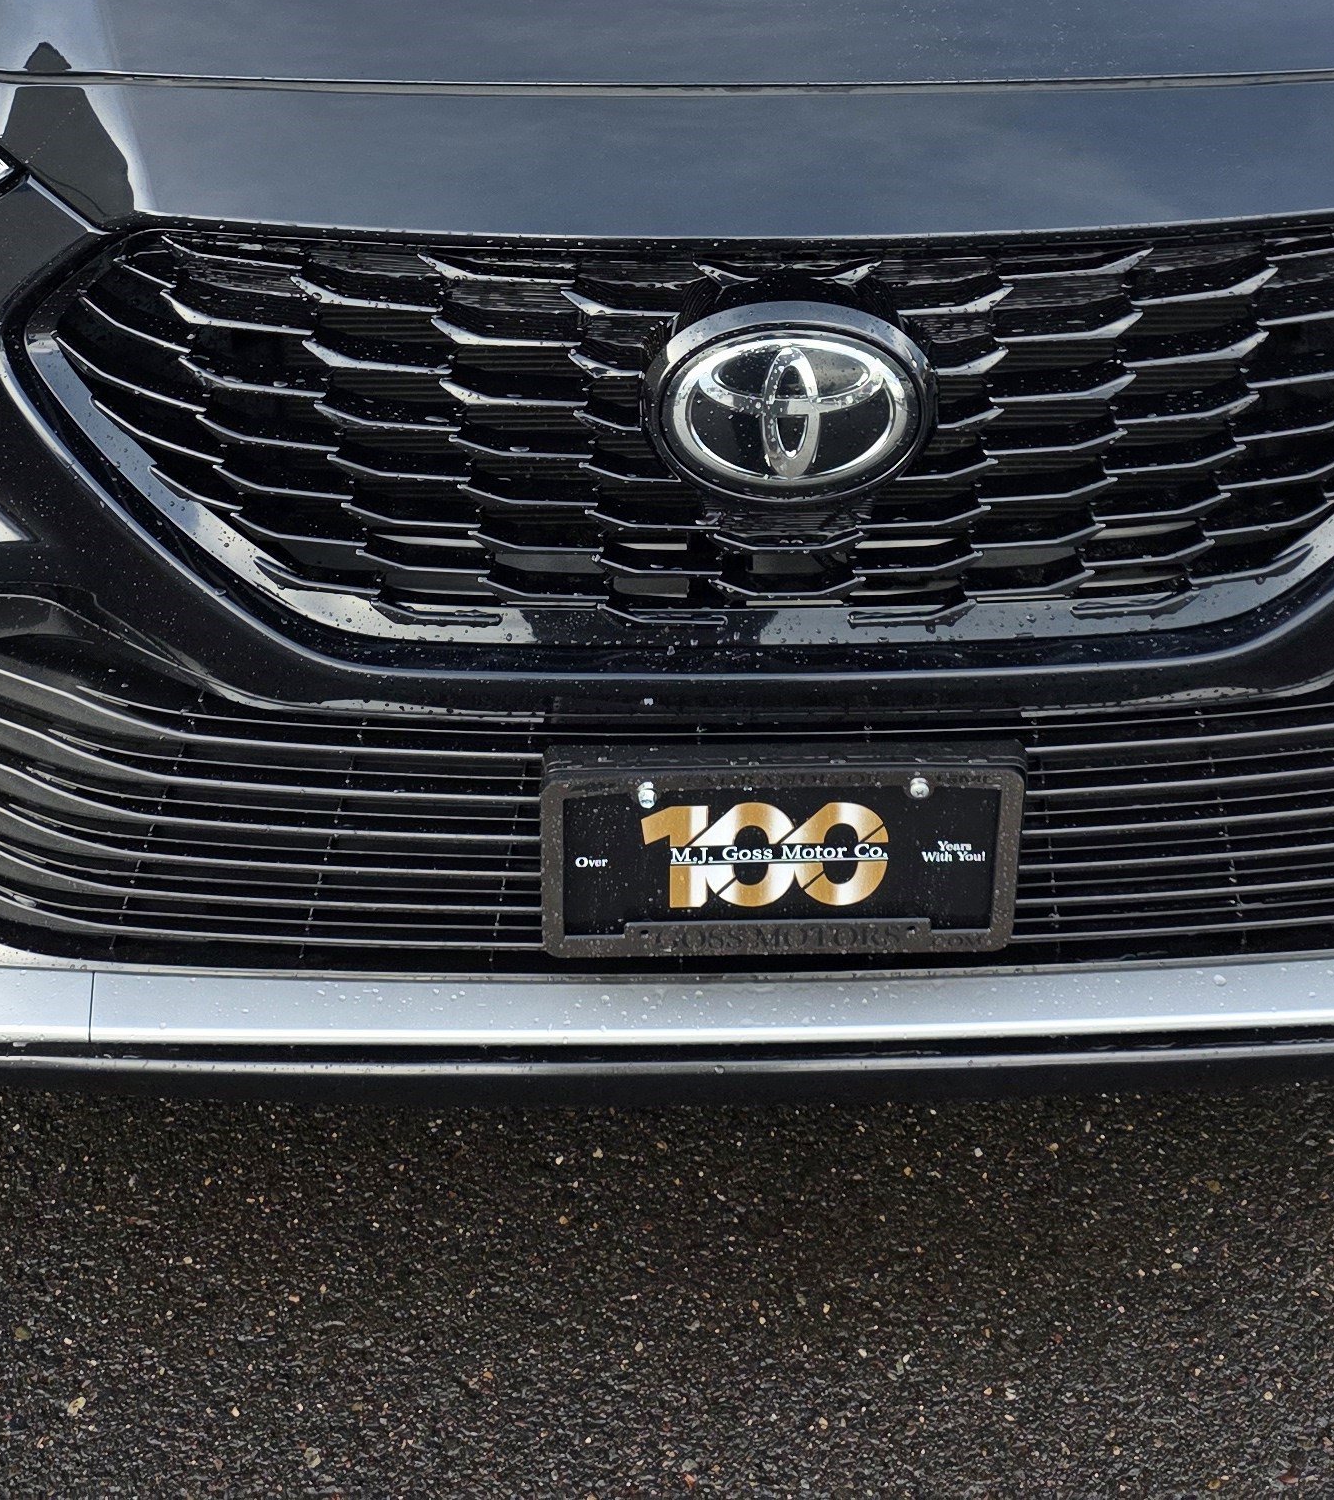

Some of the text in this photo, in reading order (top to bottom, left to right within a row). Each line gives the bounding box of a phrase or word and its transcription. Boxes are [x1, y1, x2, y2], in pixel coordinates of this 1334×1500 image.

[937, 840, 972, 852] Years
[641, 802, 889, 908] 100
[670, 843, 889, 864] M.J. Goss Motor Co.
[921, 850, 986, 862] With You!
[575, 856, 608, 867] Over
